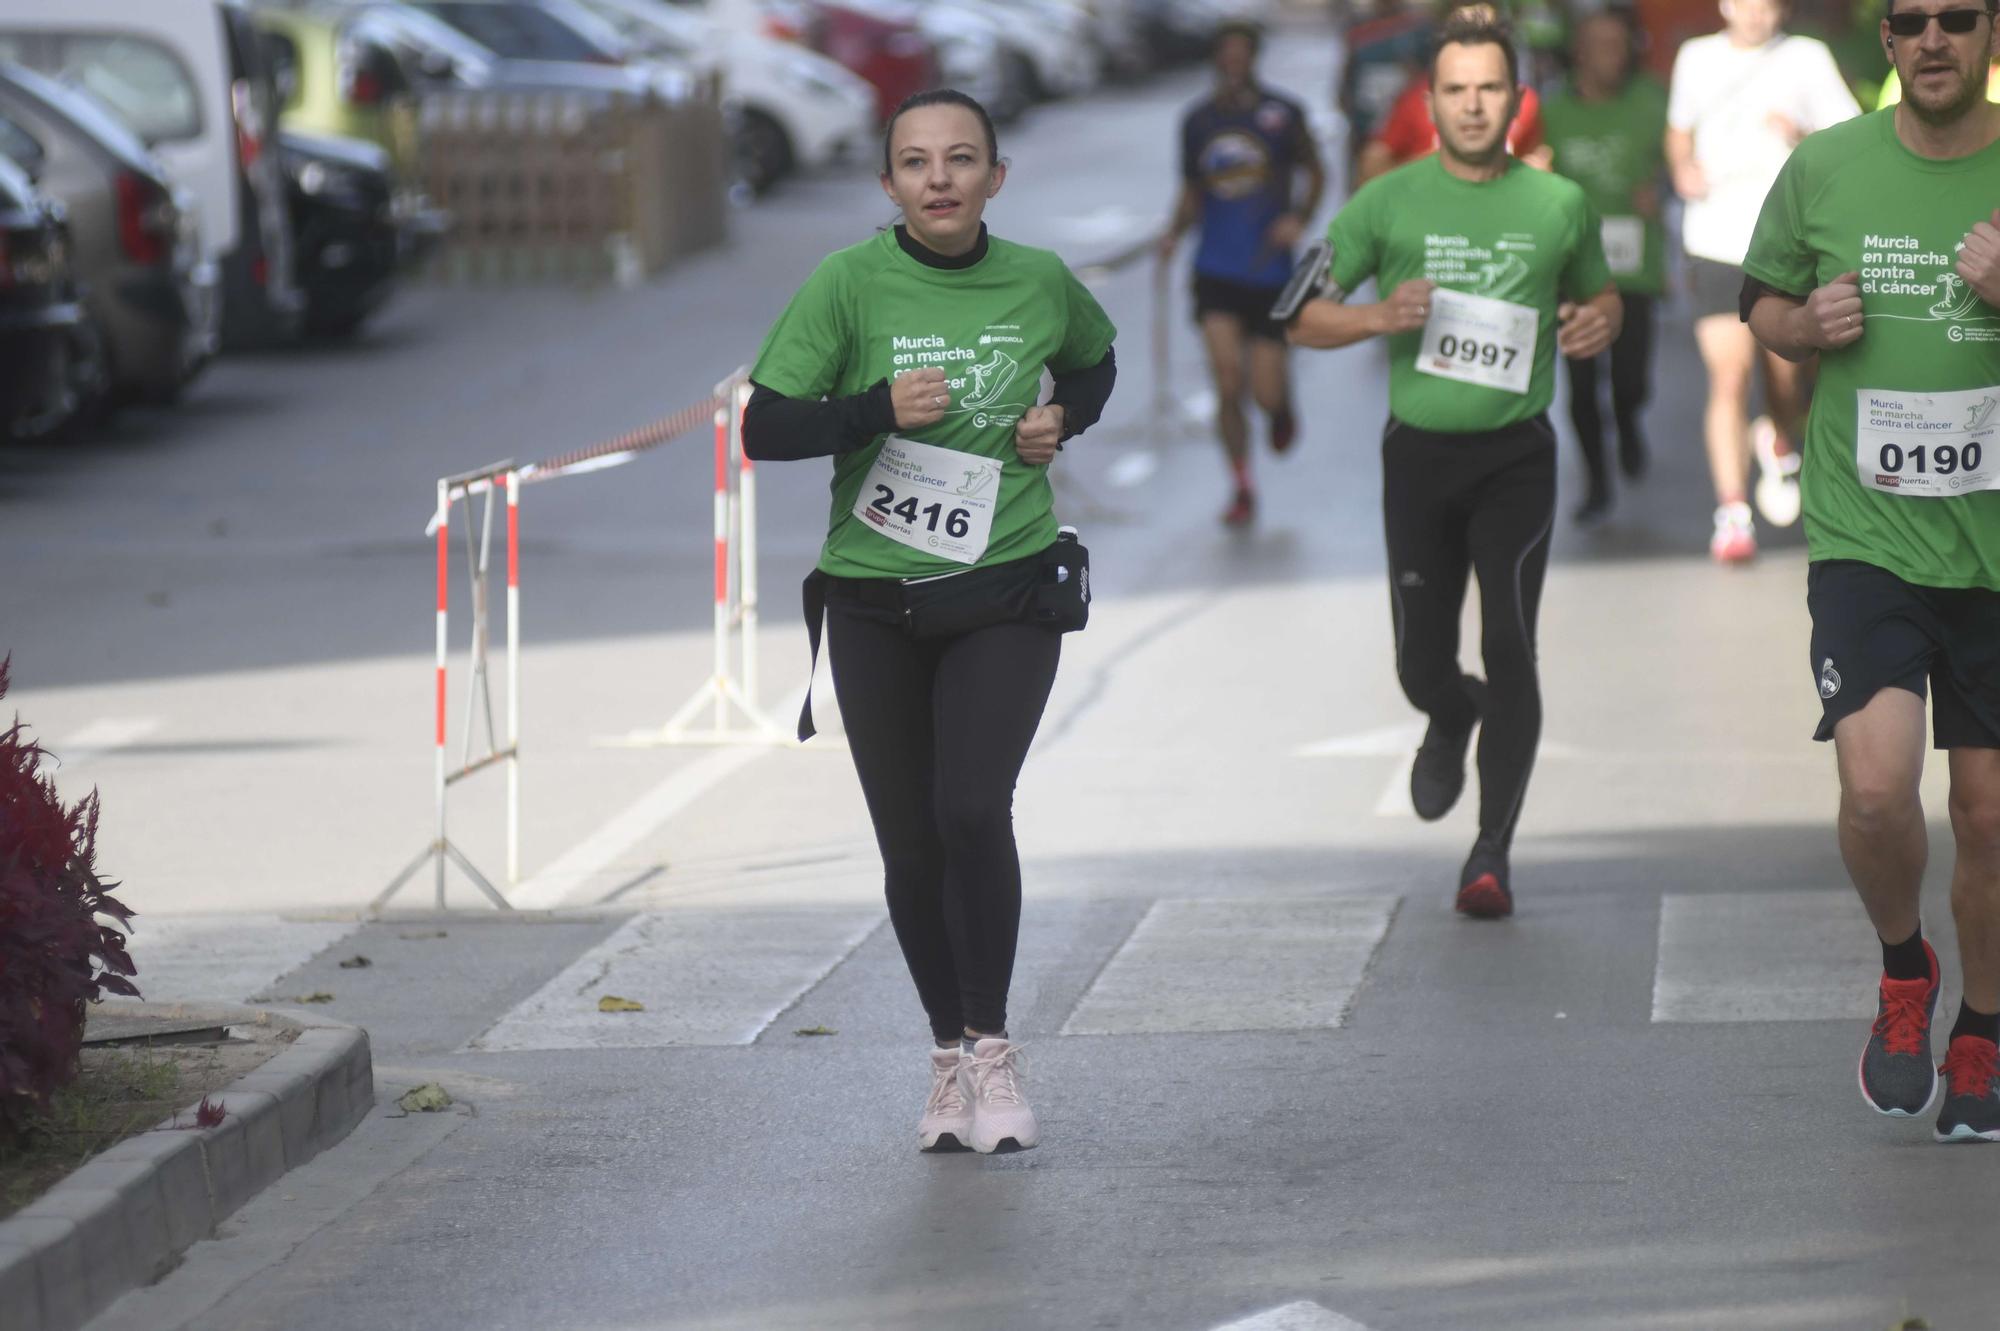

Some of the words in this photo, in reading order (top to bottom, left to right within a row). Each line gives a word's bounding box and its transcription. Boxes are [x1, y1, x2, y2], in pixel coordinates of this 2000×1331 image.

[1424, 234, 1469, 248] Murcia
[1864, 235, 1918, 249] Murcia
[1862, 252, 1882, 263] en
[1887, 251, 1949, 265] marcha
[1862, 266, 1915, 279] contra
[1862, 280, 1877, 293] el
[1880, 280, 1937, 295] cáncer
[893, 334, 945, 350] Murcia
[893, 353, 913, 365] en
[917, 347, 976, 361] marcha
[1439, 334, 1518, 370] 0997
[1870, 399, 1904, 410] Murcia
[1870, 409, 1882, 417] en
[1885, 409, 1923, 421] marcha
[1870, 418, 1902, 428] contra
[1904, 421, 1914, 429] el
[1919, 420, 1953, 430] cáncer
[885, 456, 922, 472] marcha
[1880, 442, 1982, 474] 0190
[877, 459, 899, 475] ontra
[901, 471, 912, 480] el
[913, 473, 947, 488] cáncer
[871, 484, 971, 538] 2416
